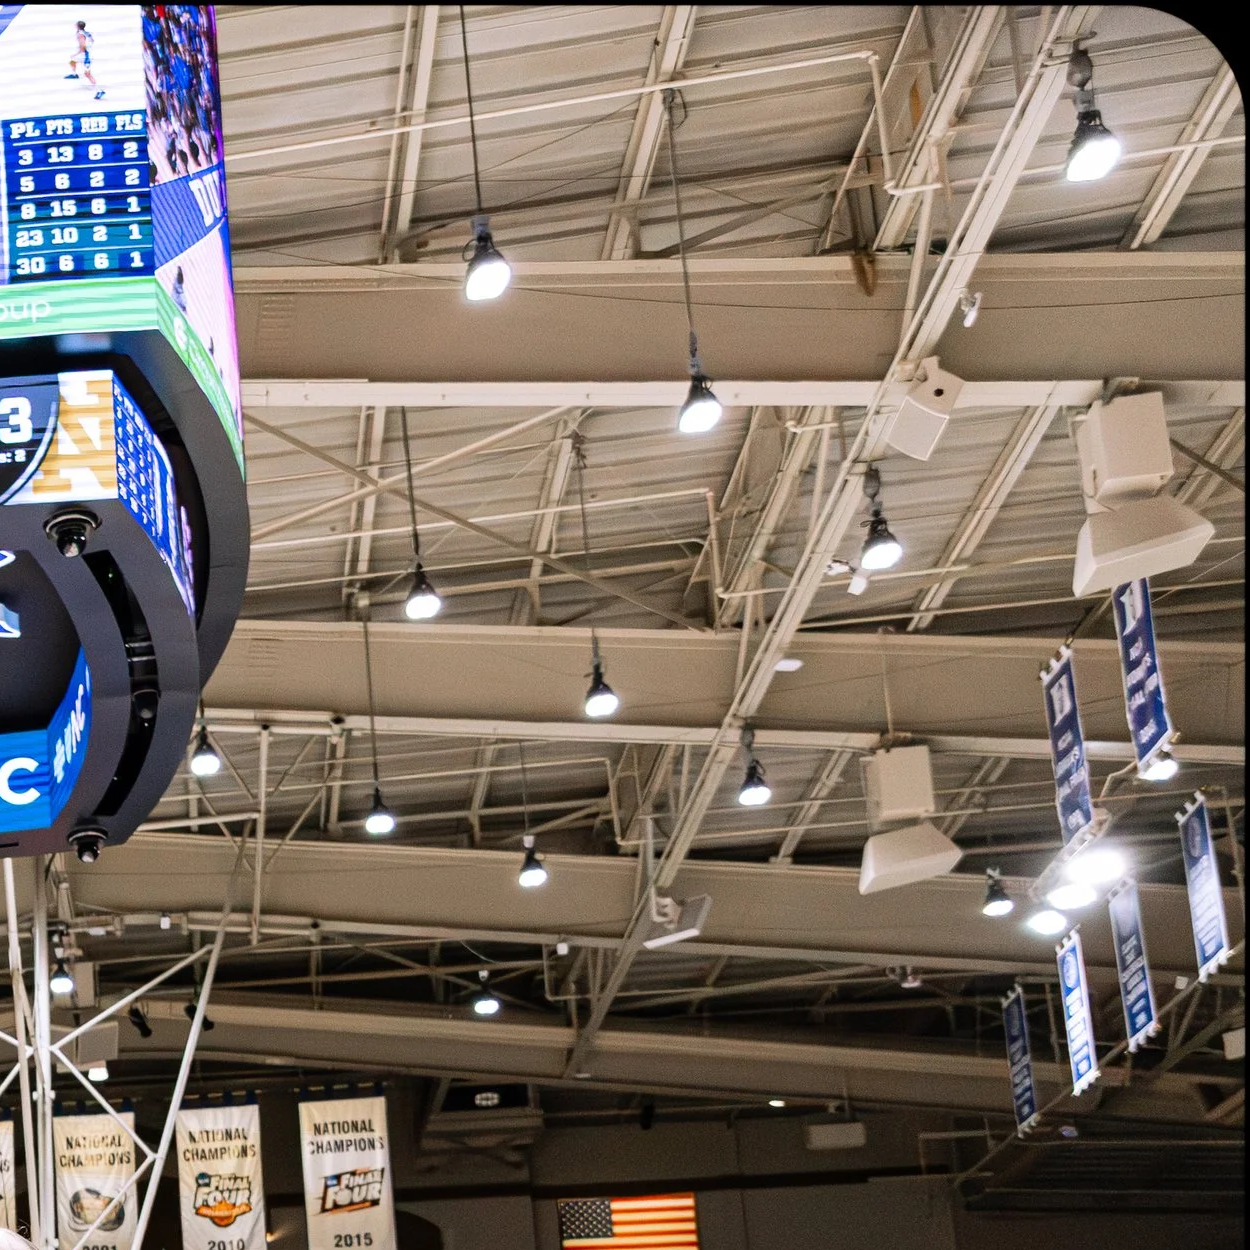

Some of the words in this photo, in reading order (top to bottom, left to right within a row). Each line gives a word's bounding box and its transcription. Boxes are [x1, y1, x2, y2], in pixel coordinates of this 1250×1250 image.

[10, 122, 40, 138] PL
[46, 119, 73, 135] PTS
[80, 116, 108, 133] REB
[115, 114, 143, 131] FLS
[18, 150, 33, 165] 3
[48, 146, 74, 162] 13
[88, 144, 103, 160] 8
[124, 142, 138, 158] 2
[20, 176, 35, 192] 5
[55, 173, 70, 189] 6
[90, 171, 104, 187] 2
[125, 169, 140, 185] 2
[21, 203, 36, 219] 8
[50, 200, 77, 217] 15
[91, 198, 106, 214] 6
[127, 196, 141, 212] 1
[16, 230, 43, 247] 23
[51, 227, 78, 244] 10
[93, 225, 108, 241] 2
[129, 224, 142, 239] 1
[16, 257, 45, 274] 30
[59, 255, 74, 271] 6
[94, 253, 109, 269] 6
[130, 251, 144, 267] 1
[15, 450, 26, 462] 2
[189, 1128, 247, 1143] NATIONAL
[313, 1119, 374, 1135] NATIONAL
[66, 1135, 123, 1149] NATIONAL
[309, 1137, 384, 1155] CHAMPIONS
[60, 1152, 130, 1168] CHAMPIONS
[183, 1145, 255, 1162] CHAMPIONS
[324, 1184, 382, 1210] FOUR
[334, 1233, 372, 1248] 2015
